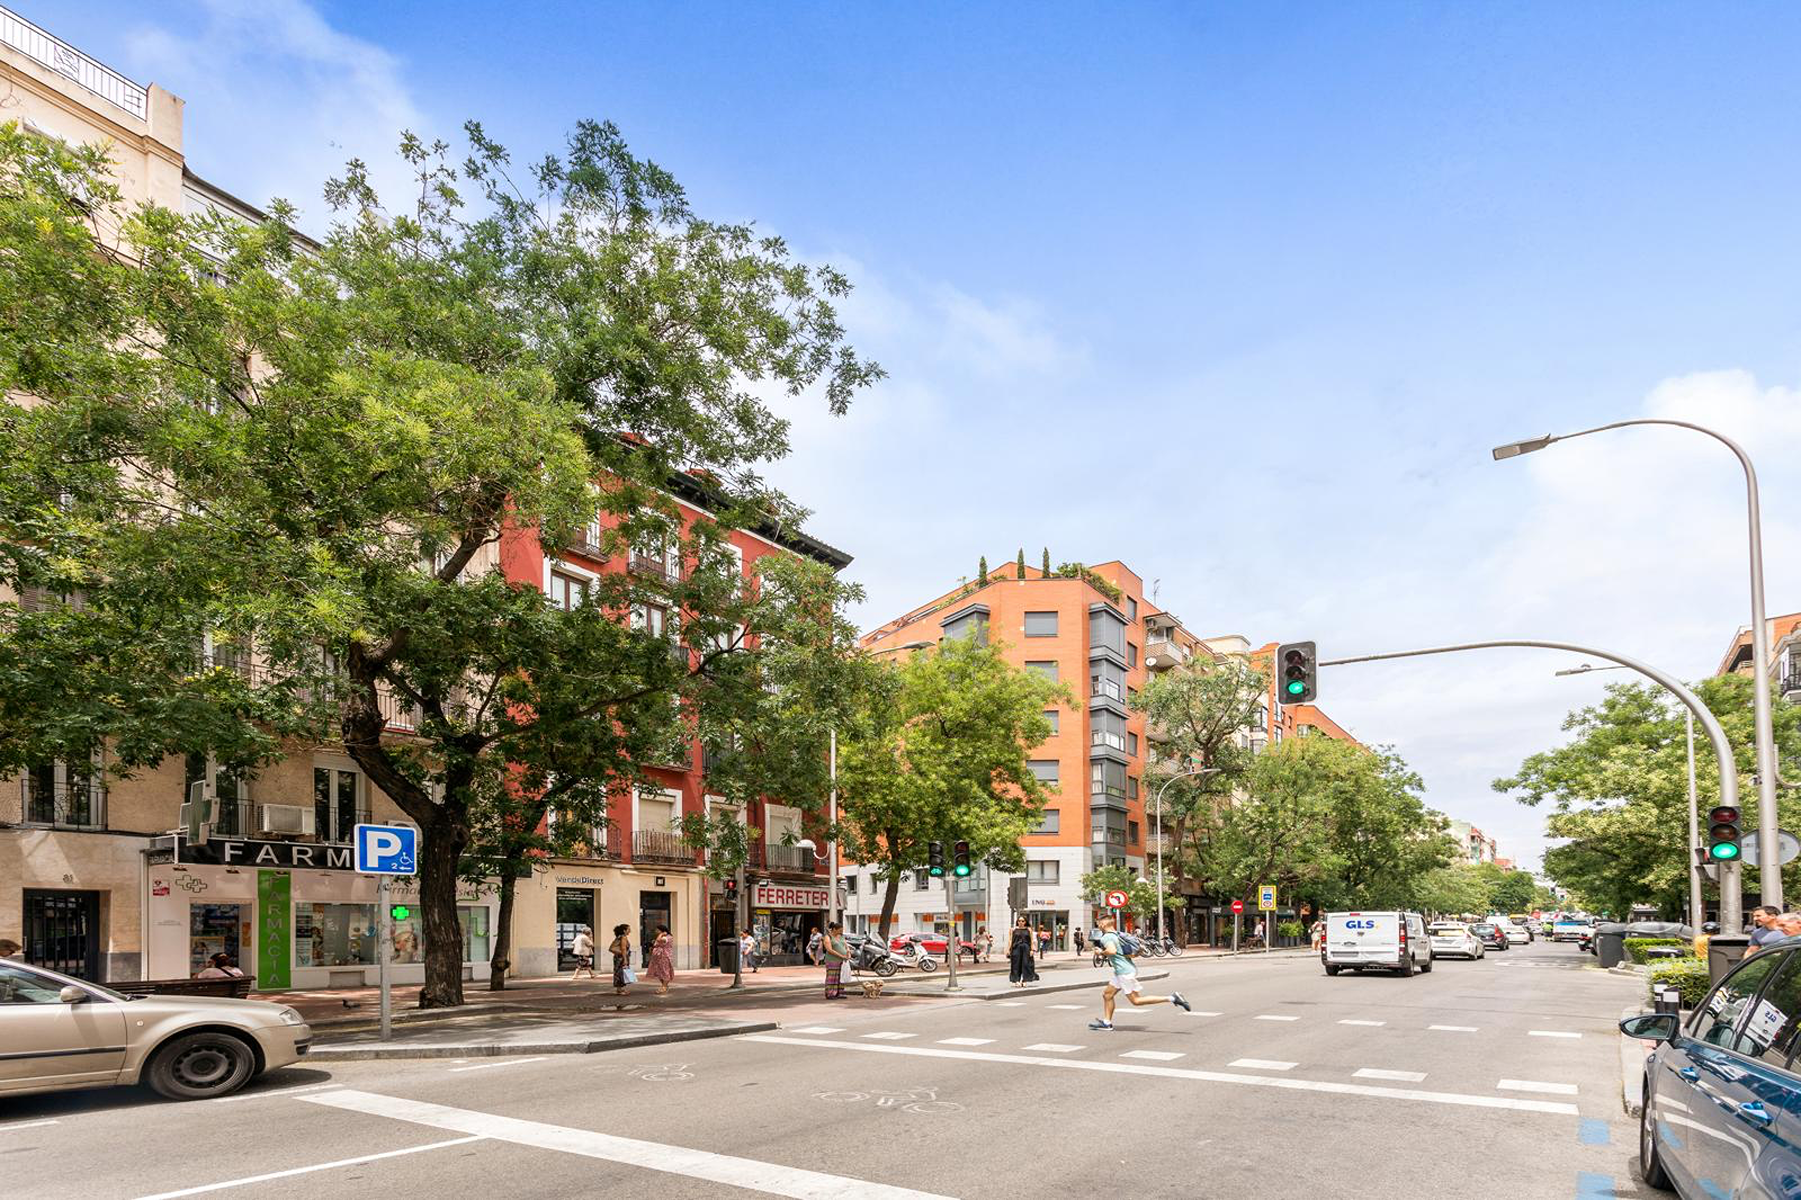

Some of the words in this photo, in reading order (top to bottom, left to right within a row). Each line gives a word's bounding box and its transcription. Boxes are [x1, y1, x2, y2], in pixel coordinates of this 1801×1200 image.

[366, 830, 402, 868] P
[757, 887, 842, 907] FERRETER
[266, 876, 283, 985] FARMACIA
[1345, 919, 1375, 929] GLS
